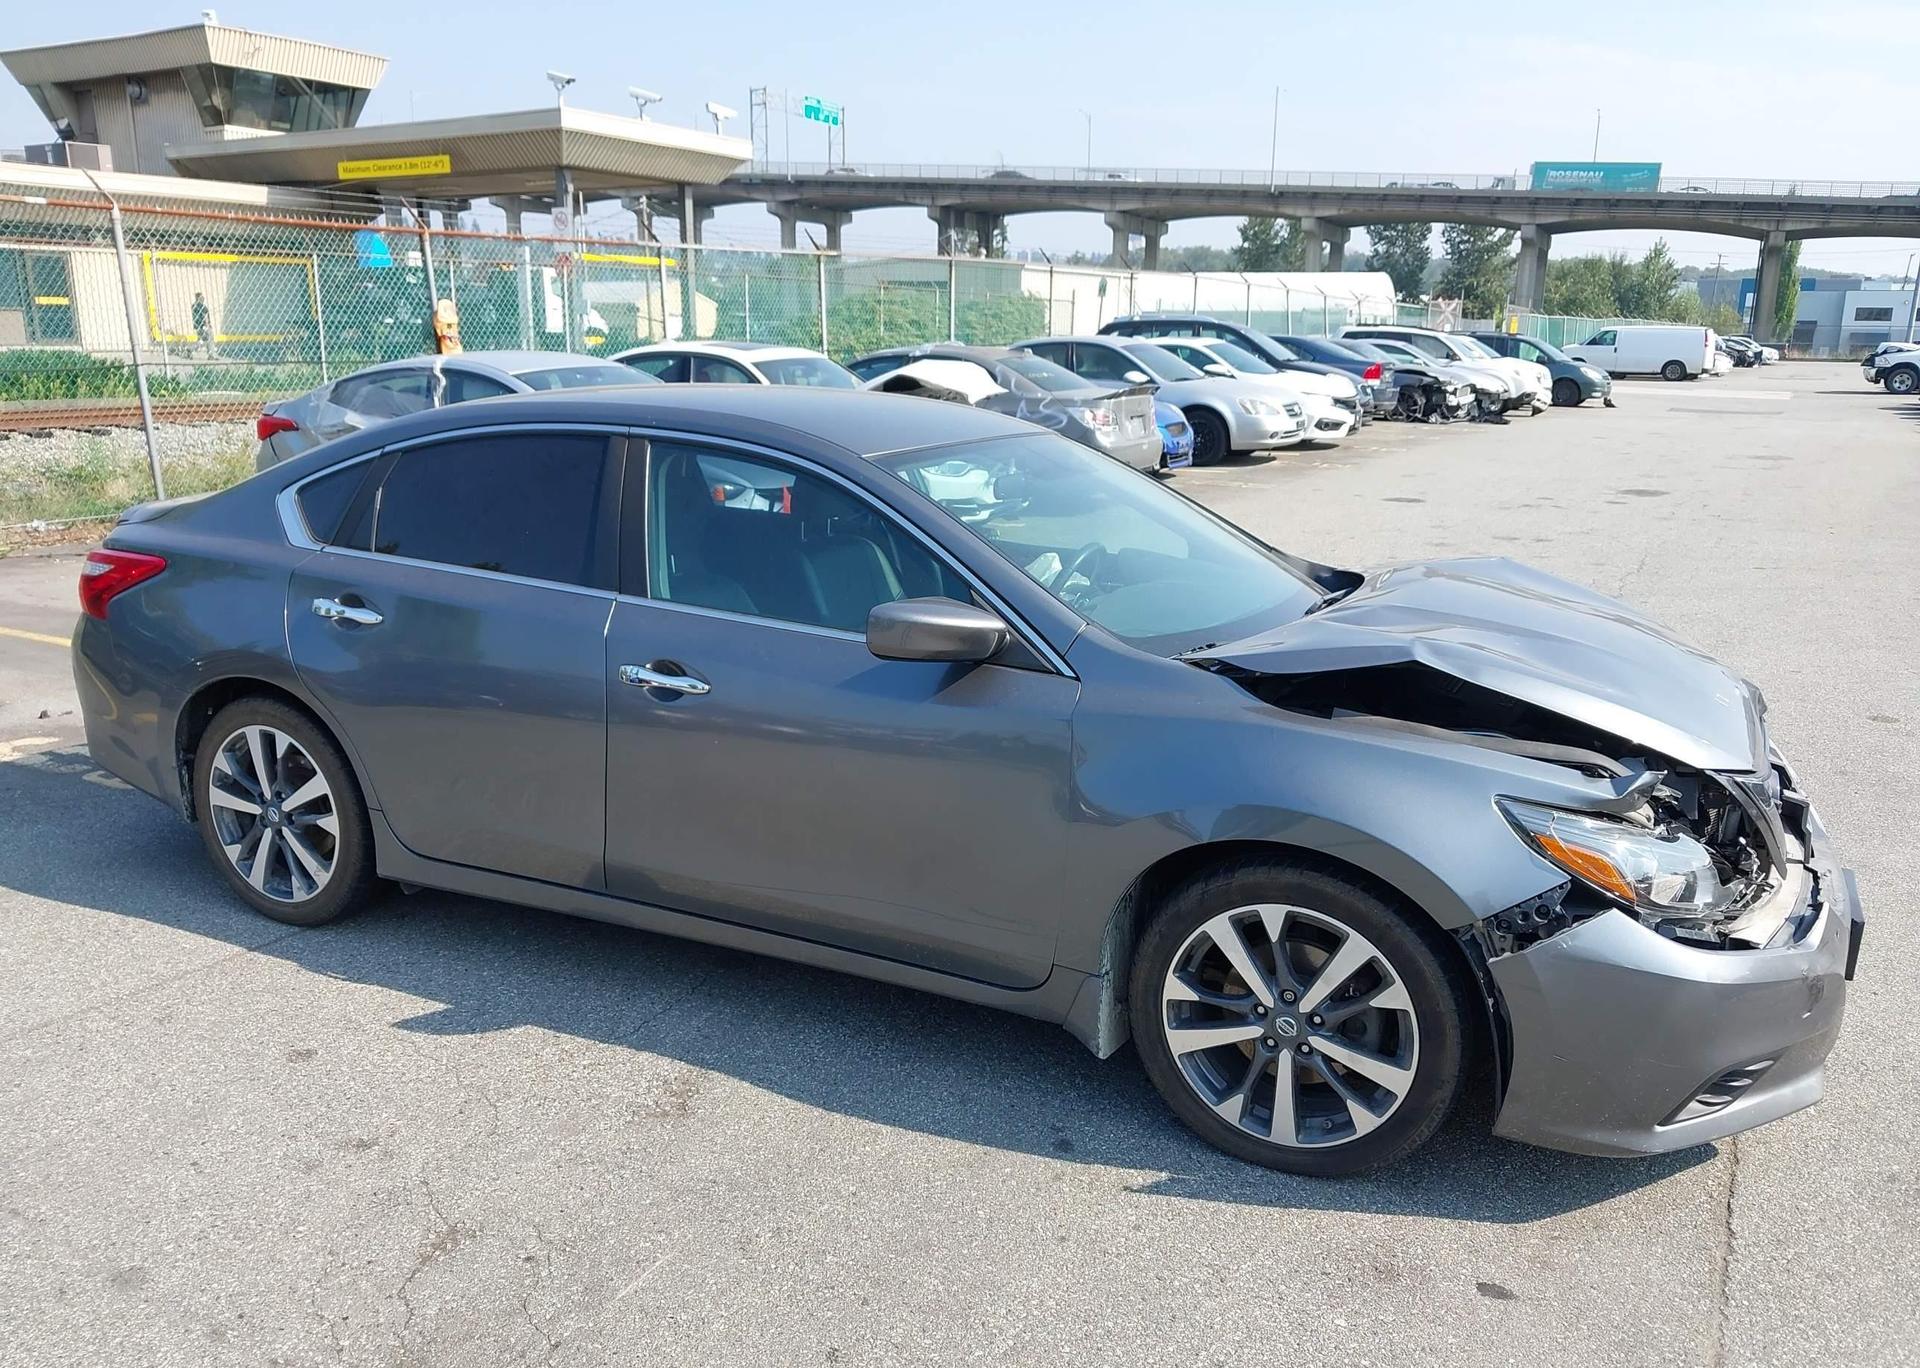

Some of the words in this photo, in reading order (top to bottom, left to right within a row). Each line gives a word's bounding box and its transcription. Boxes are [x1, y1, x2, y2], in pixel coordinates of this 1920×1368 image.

[342, 166, 371, 174] Maximum
[373, 163, 402, 172] Clearance
[1549, 170, 1604, 178] ROSENAU
